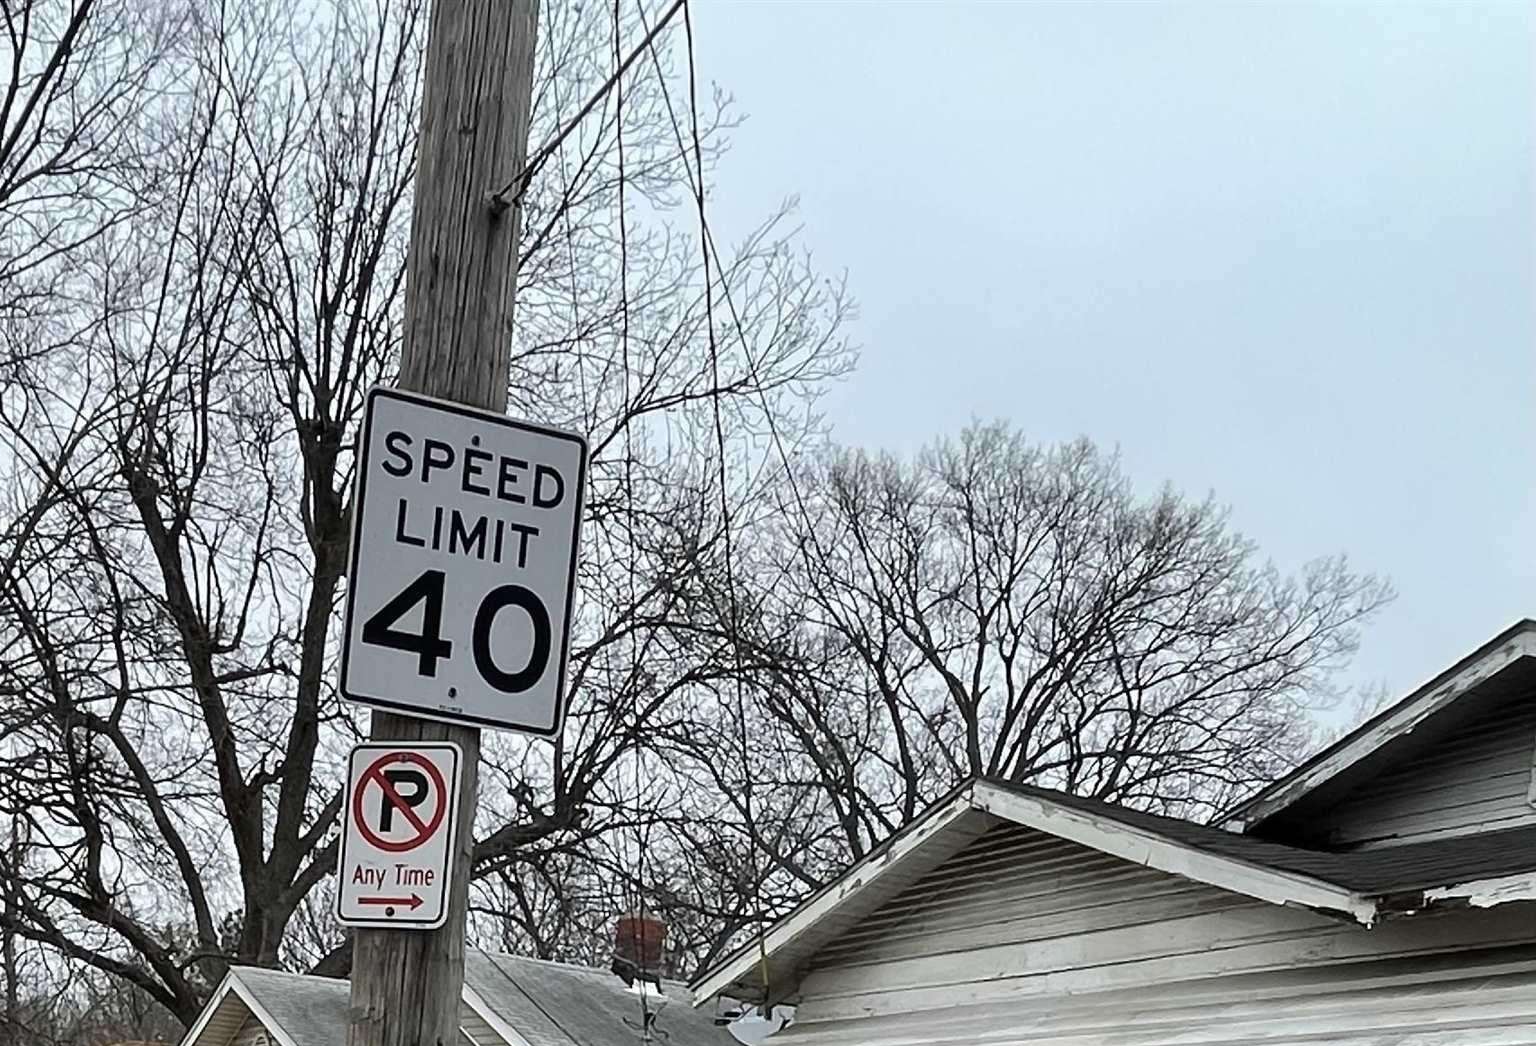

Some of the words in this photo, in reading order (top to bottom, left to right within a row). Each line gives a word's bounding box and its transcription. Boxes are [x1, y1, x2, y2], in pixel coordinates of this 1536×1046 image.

[381, 431, 565, 509] SPEED
[396, 499, 540, 568] LIMIT
[362, 569, 552, 694] 40
[352, 864, 387, 891] Any
[395, 863, 434, 886] Time
